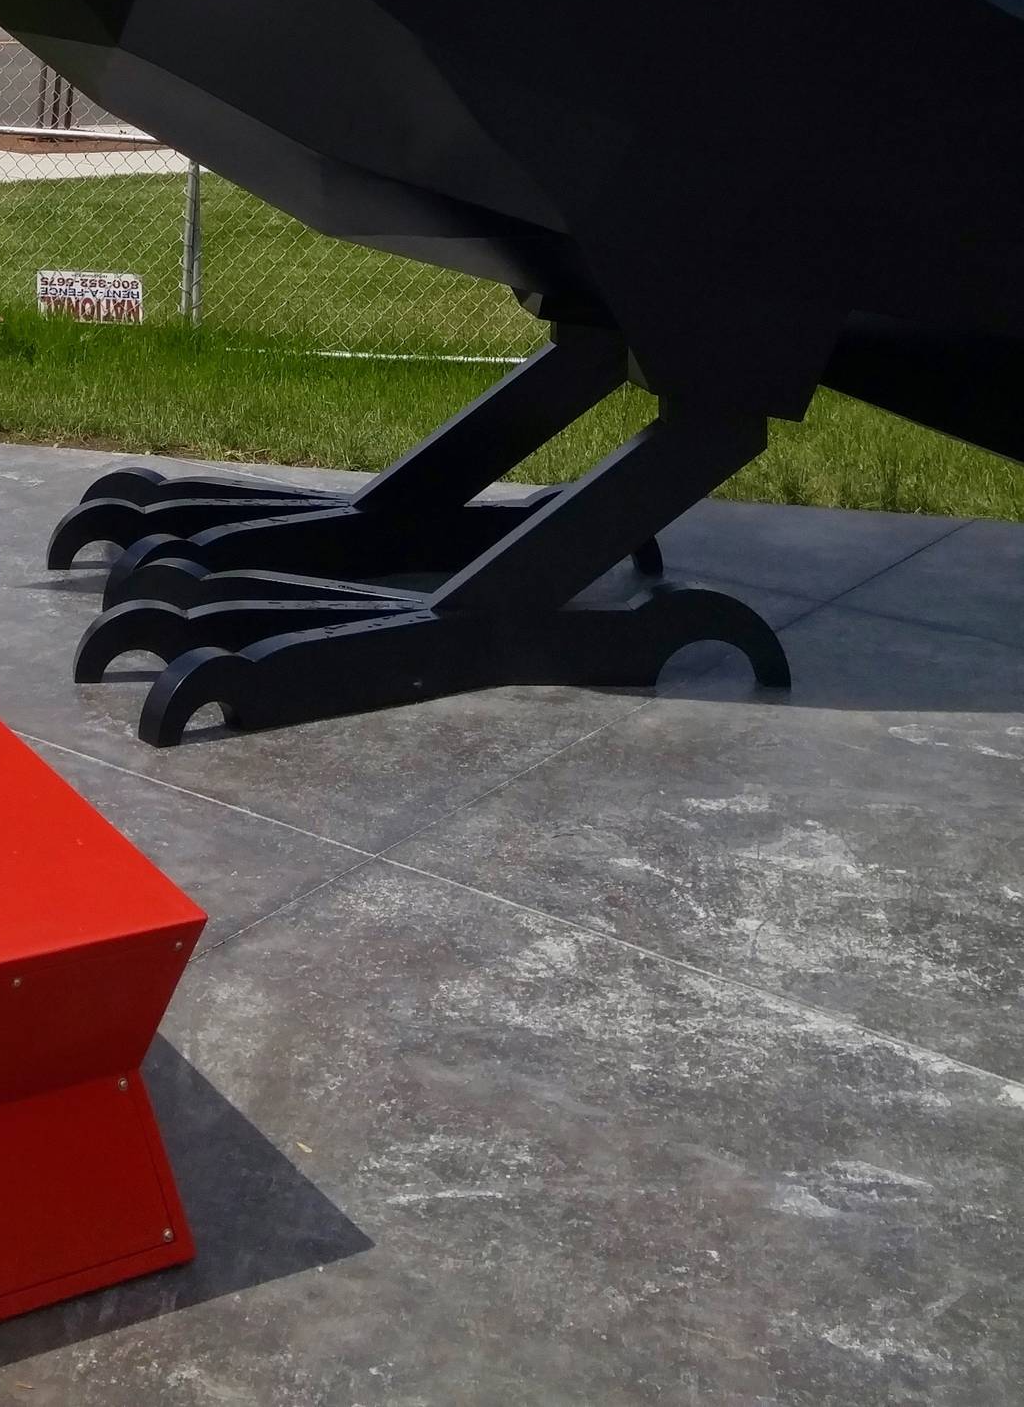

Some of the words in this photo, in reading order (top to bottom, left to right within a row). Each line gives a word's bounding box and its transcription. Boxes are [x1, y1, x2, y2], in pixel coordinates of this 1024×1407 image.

[40, 277, 139, 290] 800-352-5675
[40, 287, 140, 299] RENT-A-FENCE
[40, 296, 140, 323] NATIONAL
